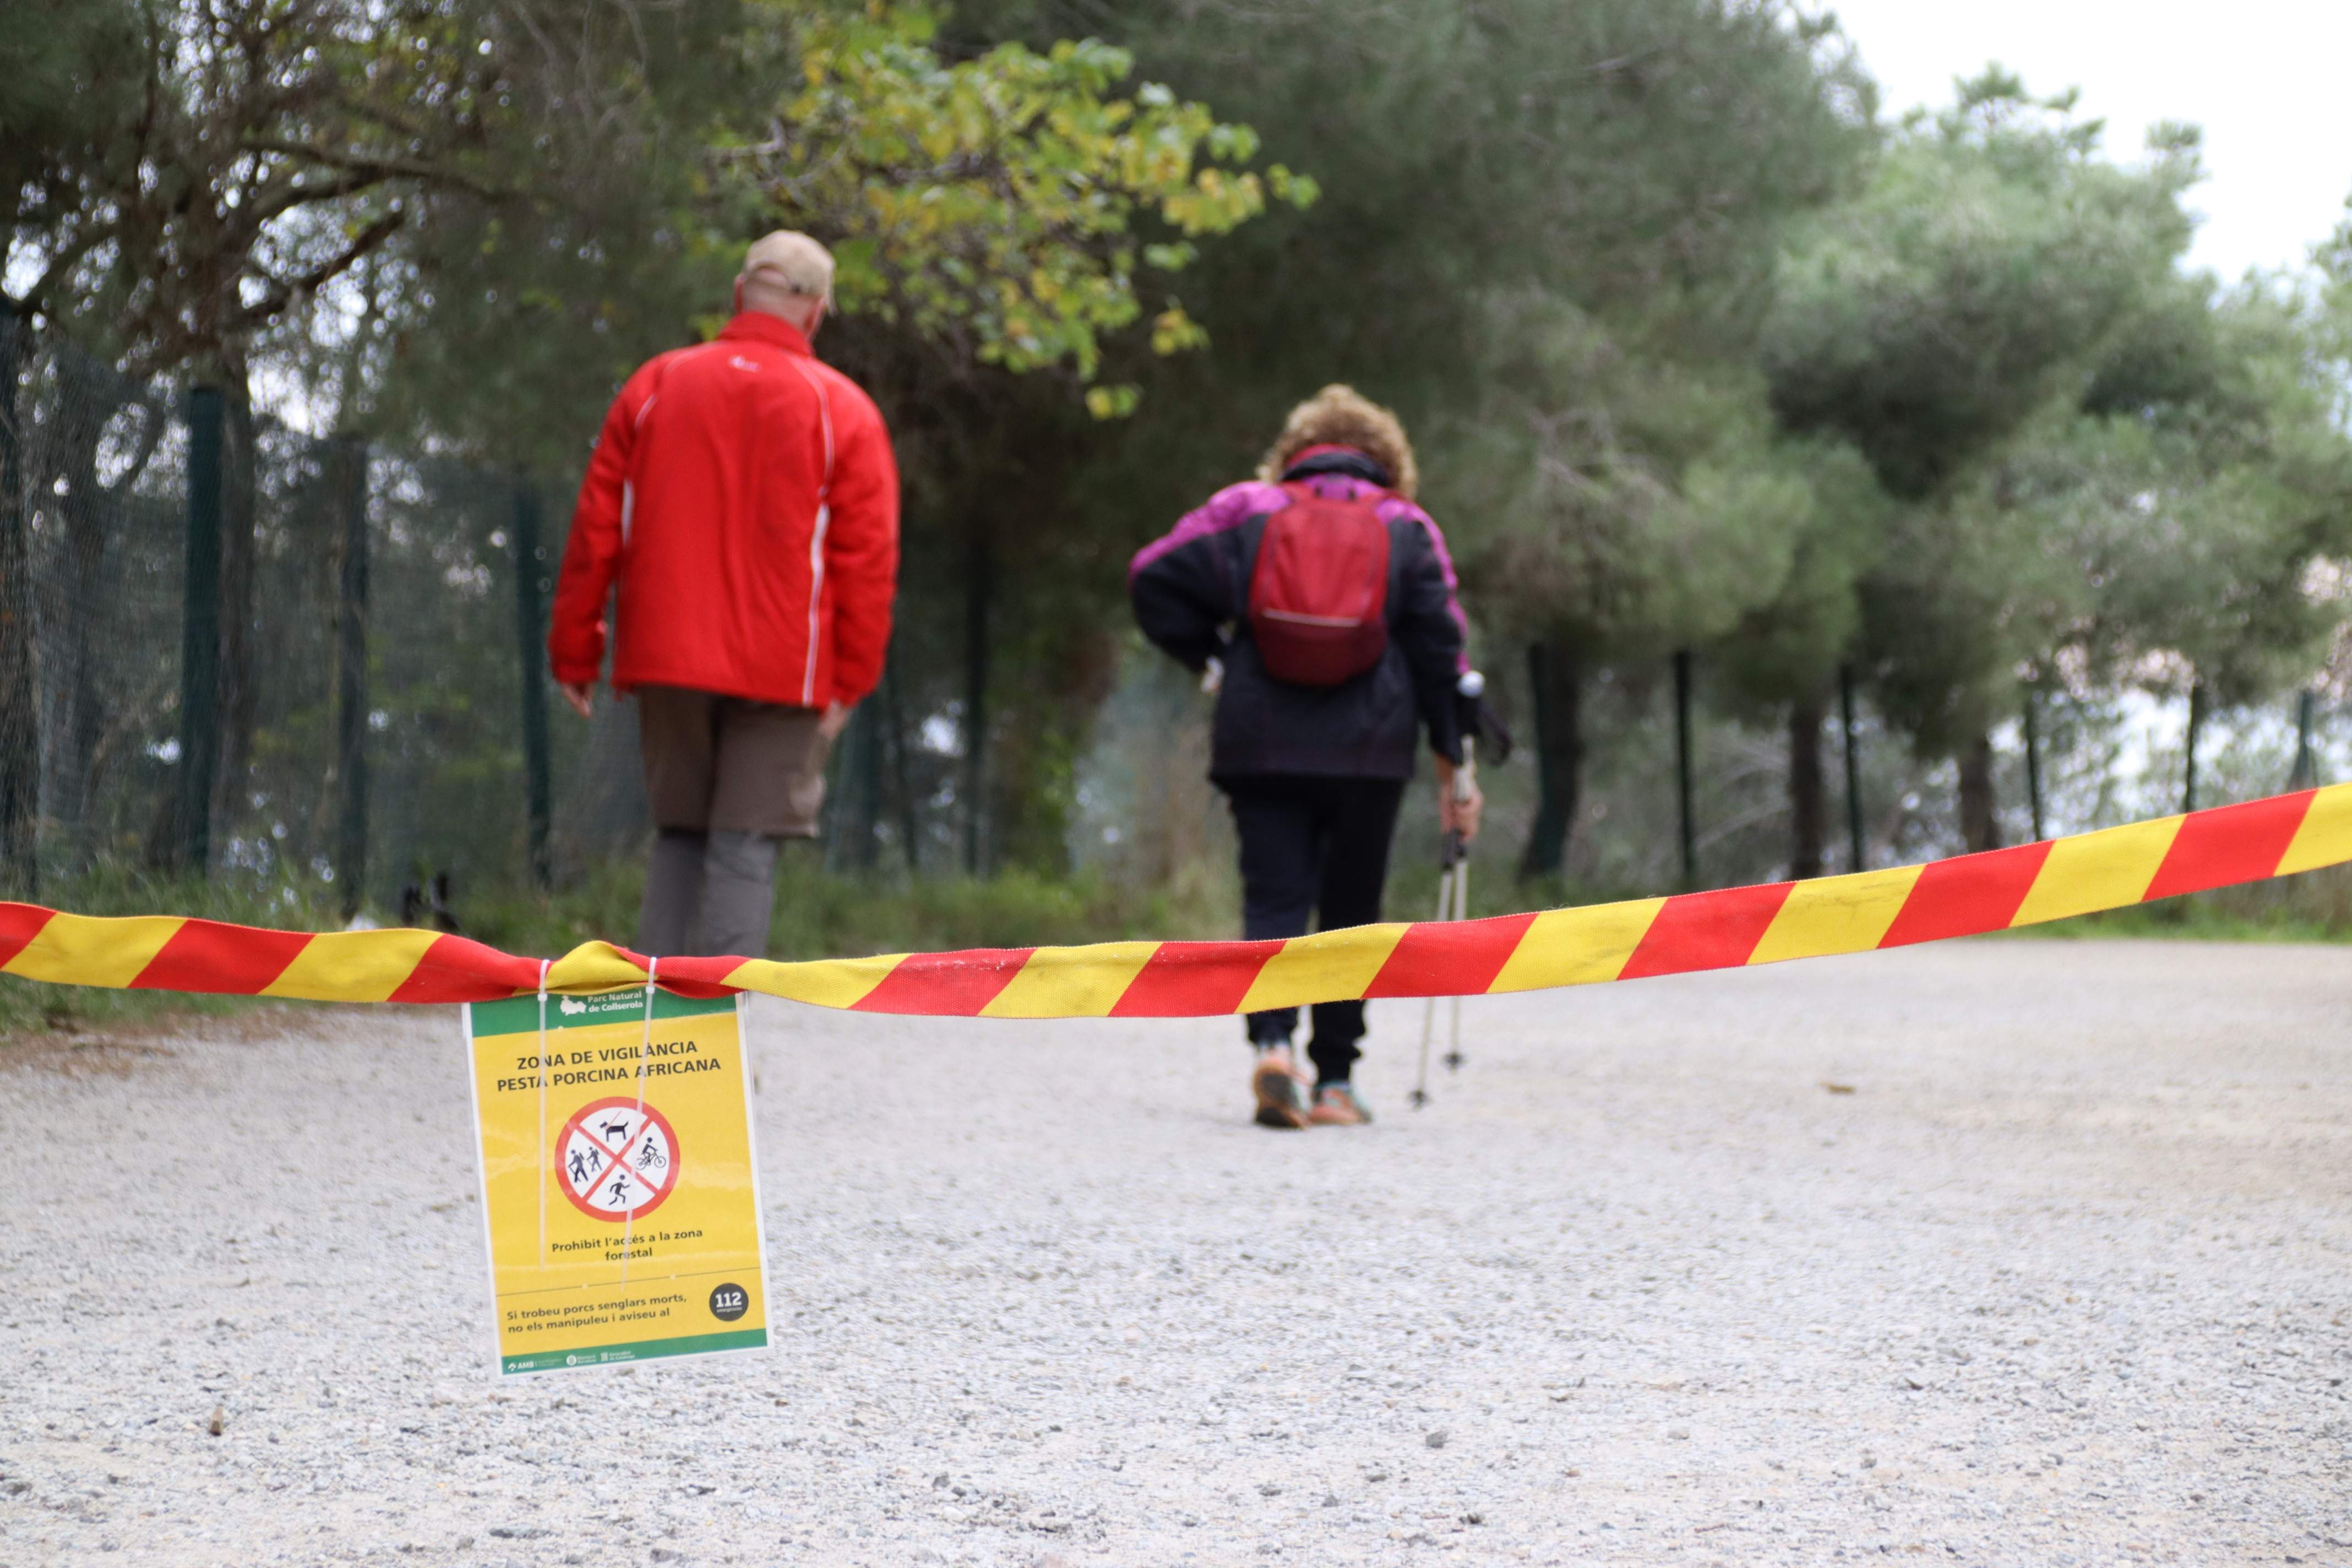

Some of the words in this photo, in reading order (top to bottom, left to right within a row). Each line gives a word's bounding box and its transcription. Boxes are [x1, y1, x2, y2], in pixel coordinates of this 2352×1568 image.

[587, 995, 606, 1003] Parc
[609, 991, 643, 1001] Natural
[602, 1001, 643, 1011] Collserola
[517, 1054, 565, 1070] ZONA
[571, 1051, 593, 1065] DE
[598, 1041, 698, 1061] VIGILÀNCIA
[497, 1075, 548, 1092] PESTA
[553, 1067, 629, 1086] PORCINA
[634, 1058, 721, 1078] AFRICANA
[552, 1239, 601, 1253] Prohibit
[660, 1231, 670, 1241] la
[674, 1229, 703, 1240] zona
[605, 1247, 652, 1261] forestal
[507, 1311, 517, 1320] Si
[521, 1308, 560, 1319] trobeu
[564, 1304, 594, 1318] porcs
[598, 1299, 646, 1311] senglars
[650, 1294, 687, 1305] morts,
[715, 1292, 742, 1308] 112
[508, 1325, 523, 1333] no
[527, 1322, 542, 1332] els
[546, 1315, 608, 1330] manipuleu
[612, 1314, 616, 1322] i
[619, 1310, 656, 1321] aviseu
[659, 1308, 670, 1317] al
[518, 1360, 534, 1369] AMB
